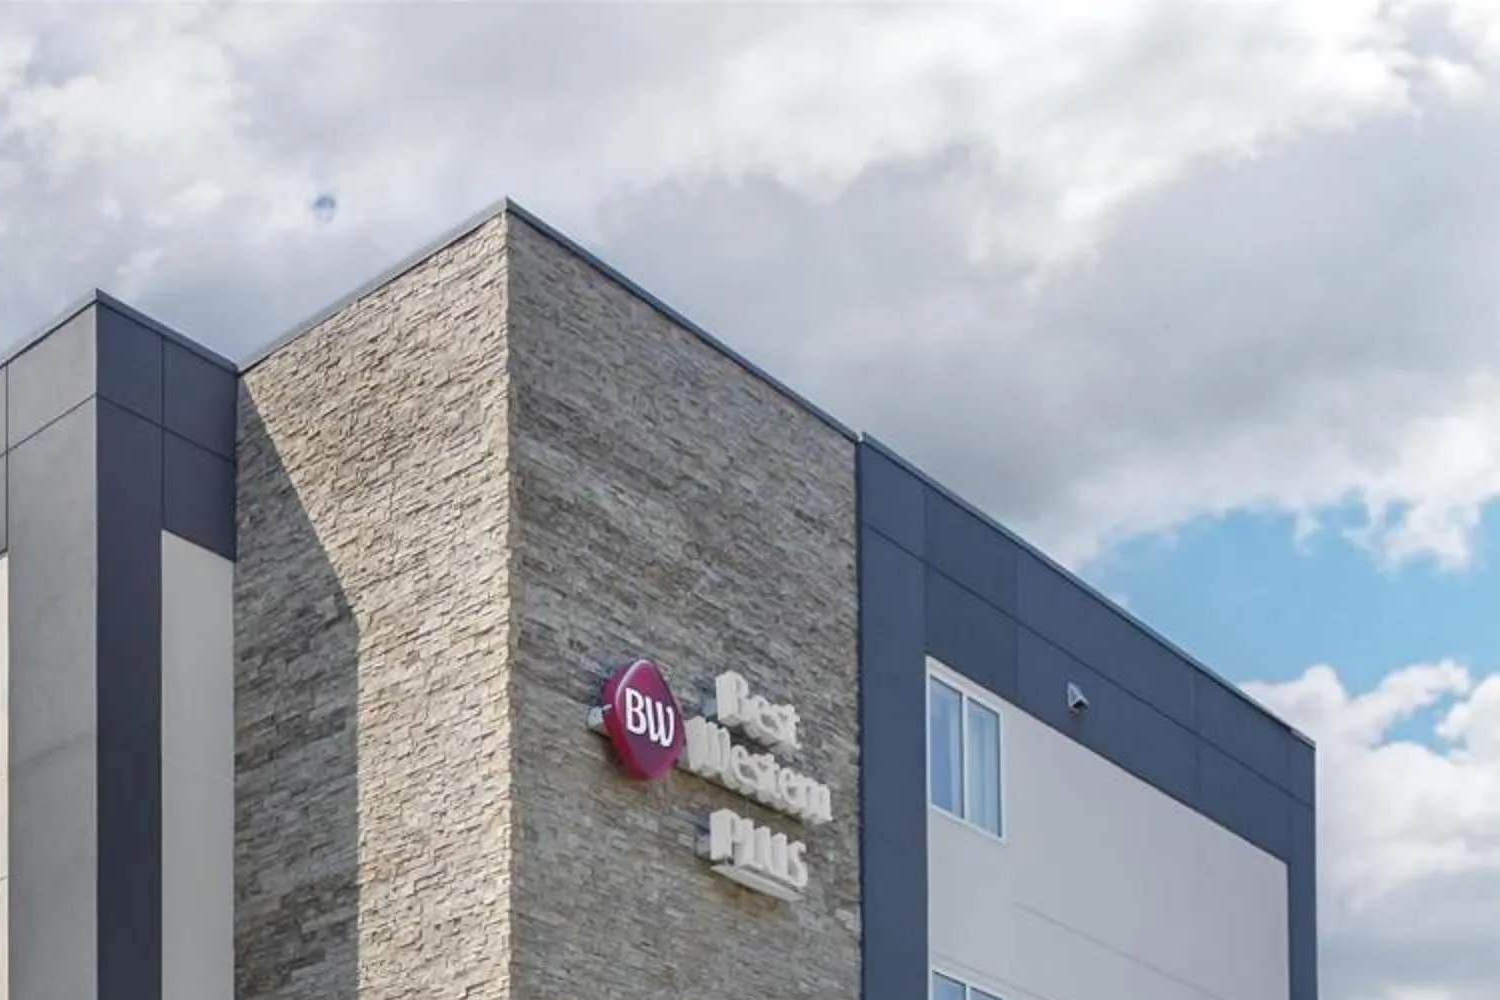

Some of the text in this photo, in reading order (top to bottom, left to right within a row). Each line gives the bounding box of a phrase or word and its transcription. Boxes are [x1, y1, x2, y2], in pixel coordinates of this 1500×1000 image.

[625, 688, 675, 747] BW
[715, 671, 801, 749] Best
[684, 716, 832, 823] Western
[710, 808, 808, 887] Plus
